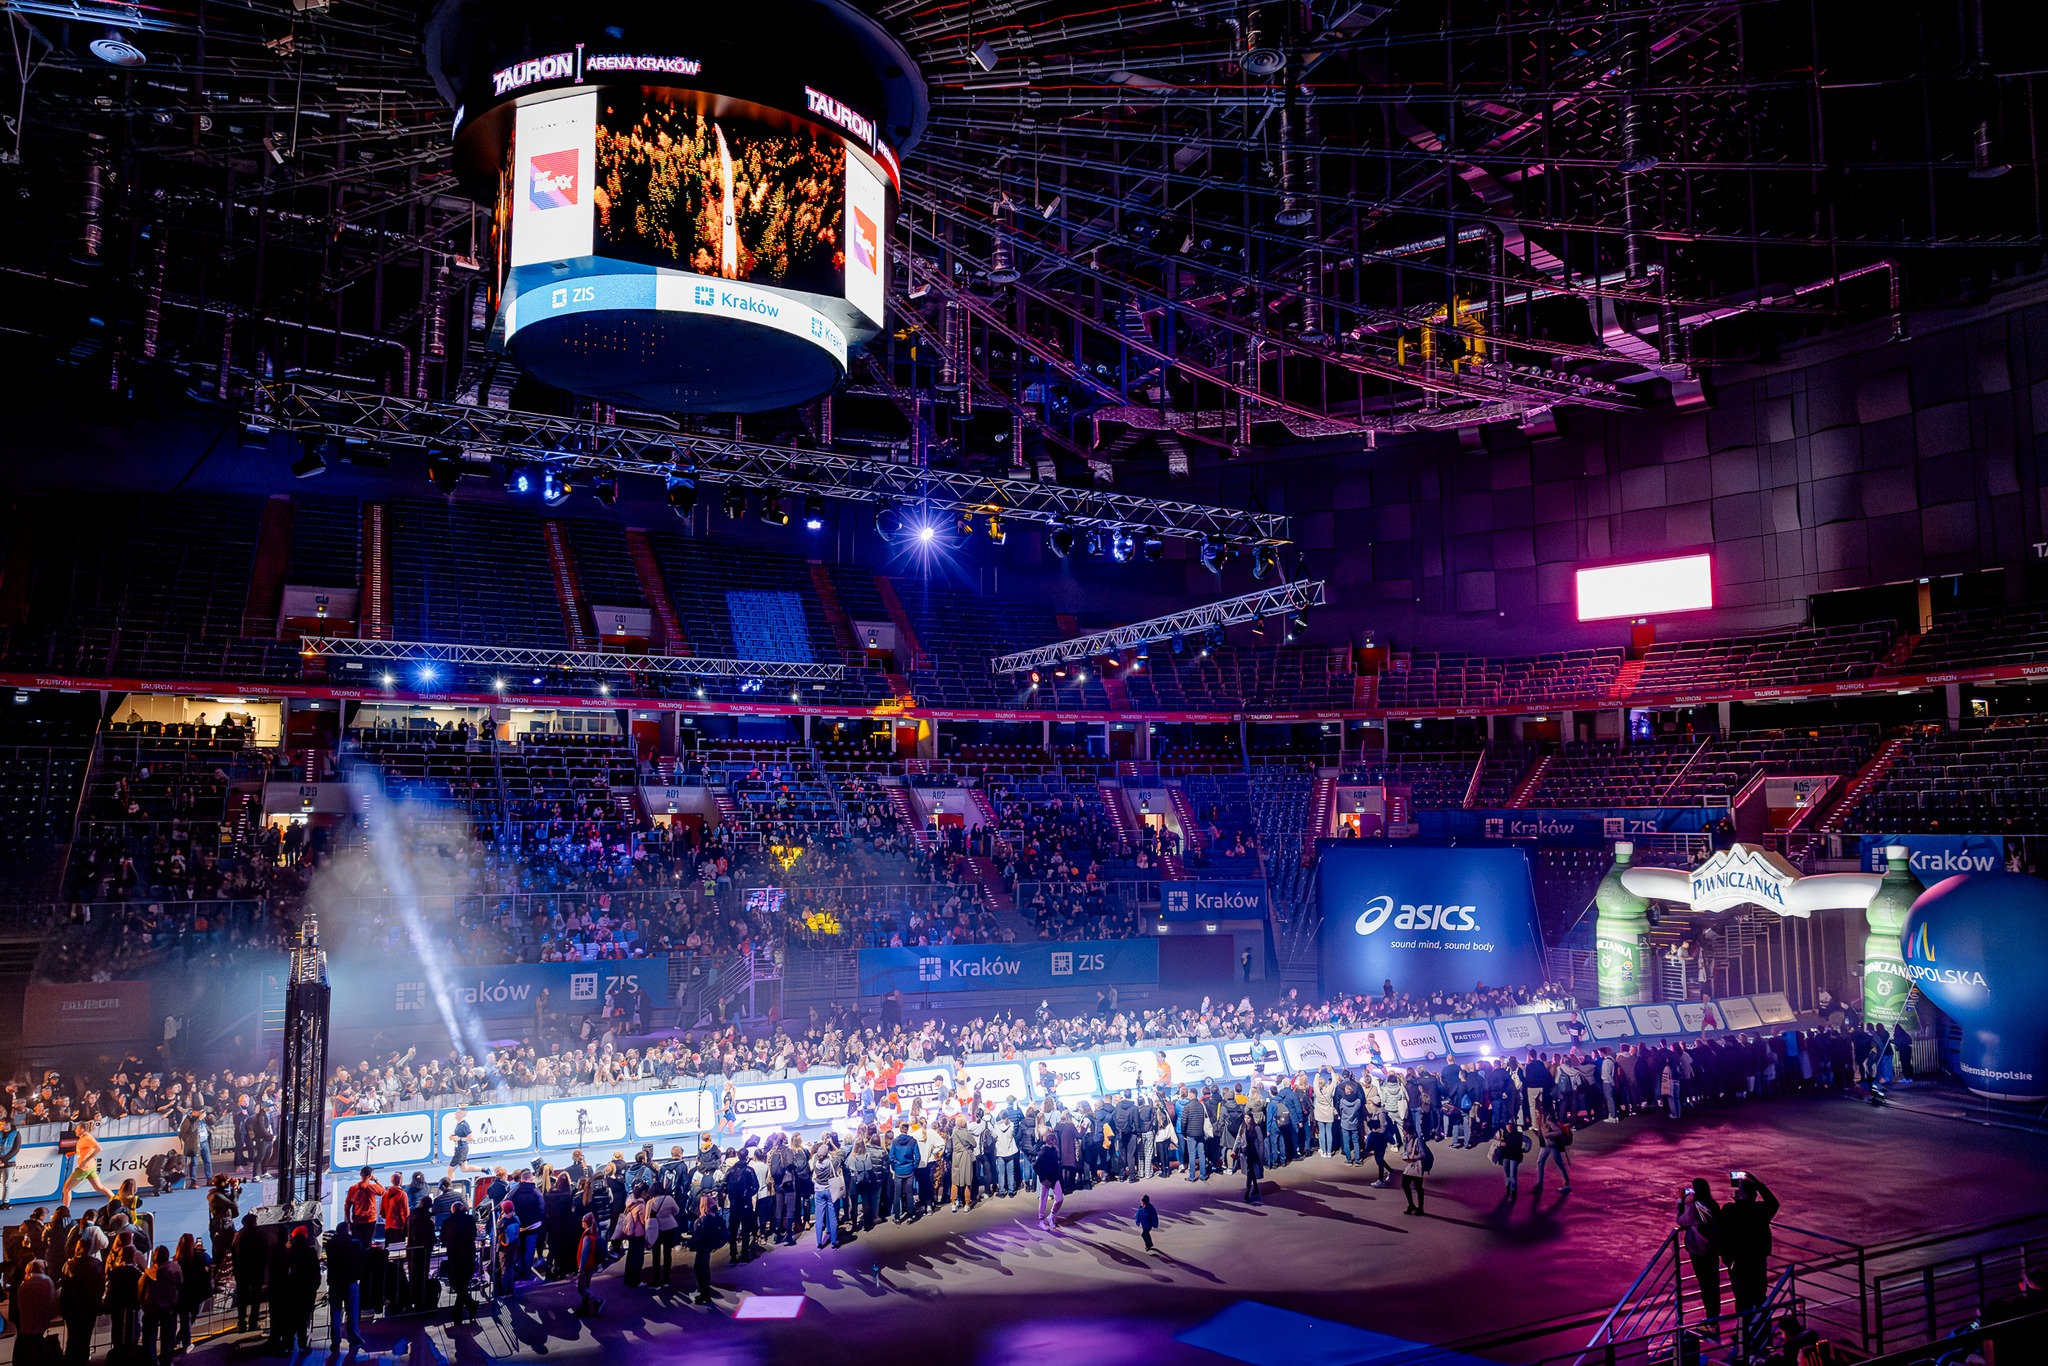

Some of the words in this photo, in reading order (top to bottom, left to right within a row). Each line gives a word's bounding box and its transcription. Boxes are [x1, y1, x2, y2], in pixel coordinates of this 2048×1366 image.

[493, 52, 573, 96] TAURON
[586, 54, 637, 71] ARENA
[636, 55, 701, 75] KRAKÓW
[805, 85, 873, 147] TAURON
[573, 287, 594, 302] ZIS
[722, 292, 779, 318] Kraków
[1926, 675, 1957, 683] TAURON
[141, 682, 173, 690] TAURON
[238, 686, 269, 694] TAURON
[1836, 683, 1864, 691] TAURON
[331, 689, 361, 697] TAURON
[418, 693, 446, 701] TAURON
[502, 696, 529, 704] TAURON
[657, 702, 683, 710] TAURON
[665, 789, 679, 799] A01
[932, 791, 946, 800] A02
[1511, 817, 1574, 835] Kraków
[1629, 820, 1657, 833] ZIS
[1909, 848, 1994, 872] Kraków
[1692, 871, 1785, 906] PIWNICZANKA
[1195, 892, 1259, 909] Kraków
[1390, 940, 1416, 949] sound
[1418, 939, 1442, 950] mind,
[1444, 940, 1471, 950] sound
[1473, 942, 1495, 953] body
[949, 956, 1021, 977] Kraków
[1078, 953, 1105, 971] ZIS
[1400, 1036, 1437, 1048] GARMIN
[1454, 1032, 1486, 1041] FACTORY
[897, 1083, 939, 1098] OSHEE
[736, 1097, 785, 1113] OSHEE
[650, 1116, 699, 1128] MAŁOPOLSKA
[367, 1131, 424, 1148] Kraków
[468, 1134, 515, 1145] ŁOPOLSKA
[109, 1155, 149, 1172] Krak
